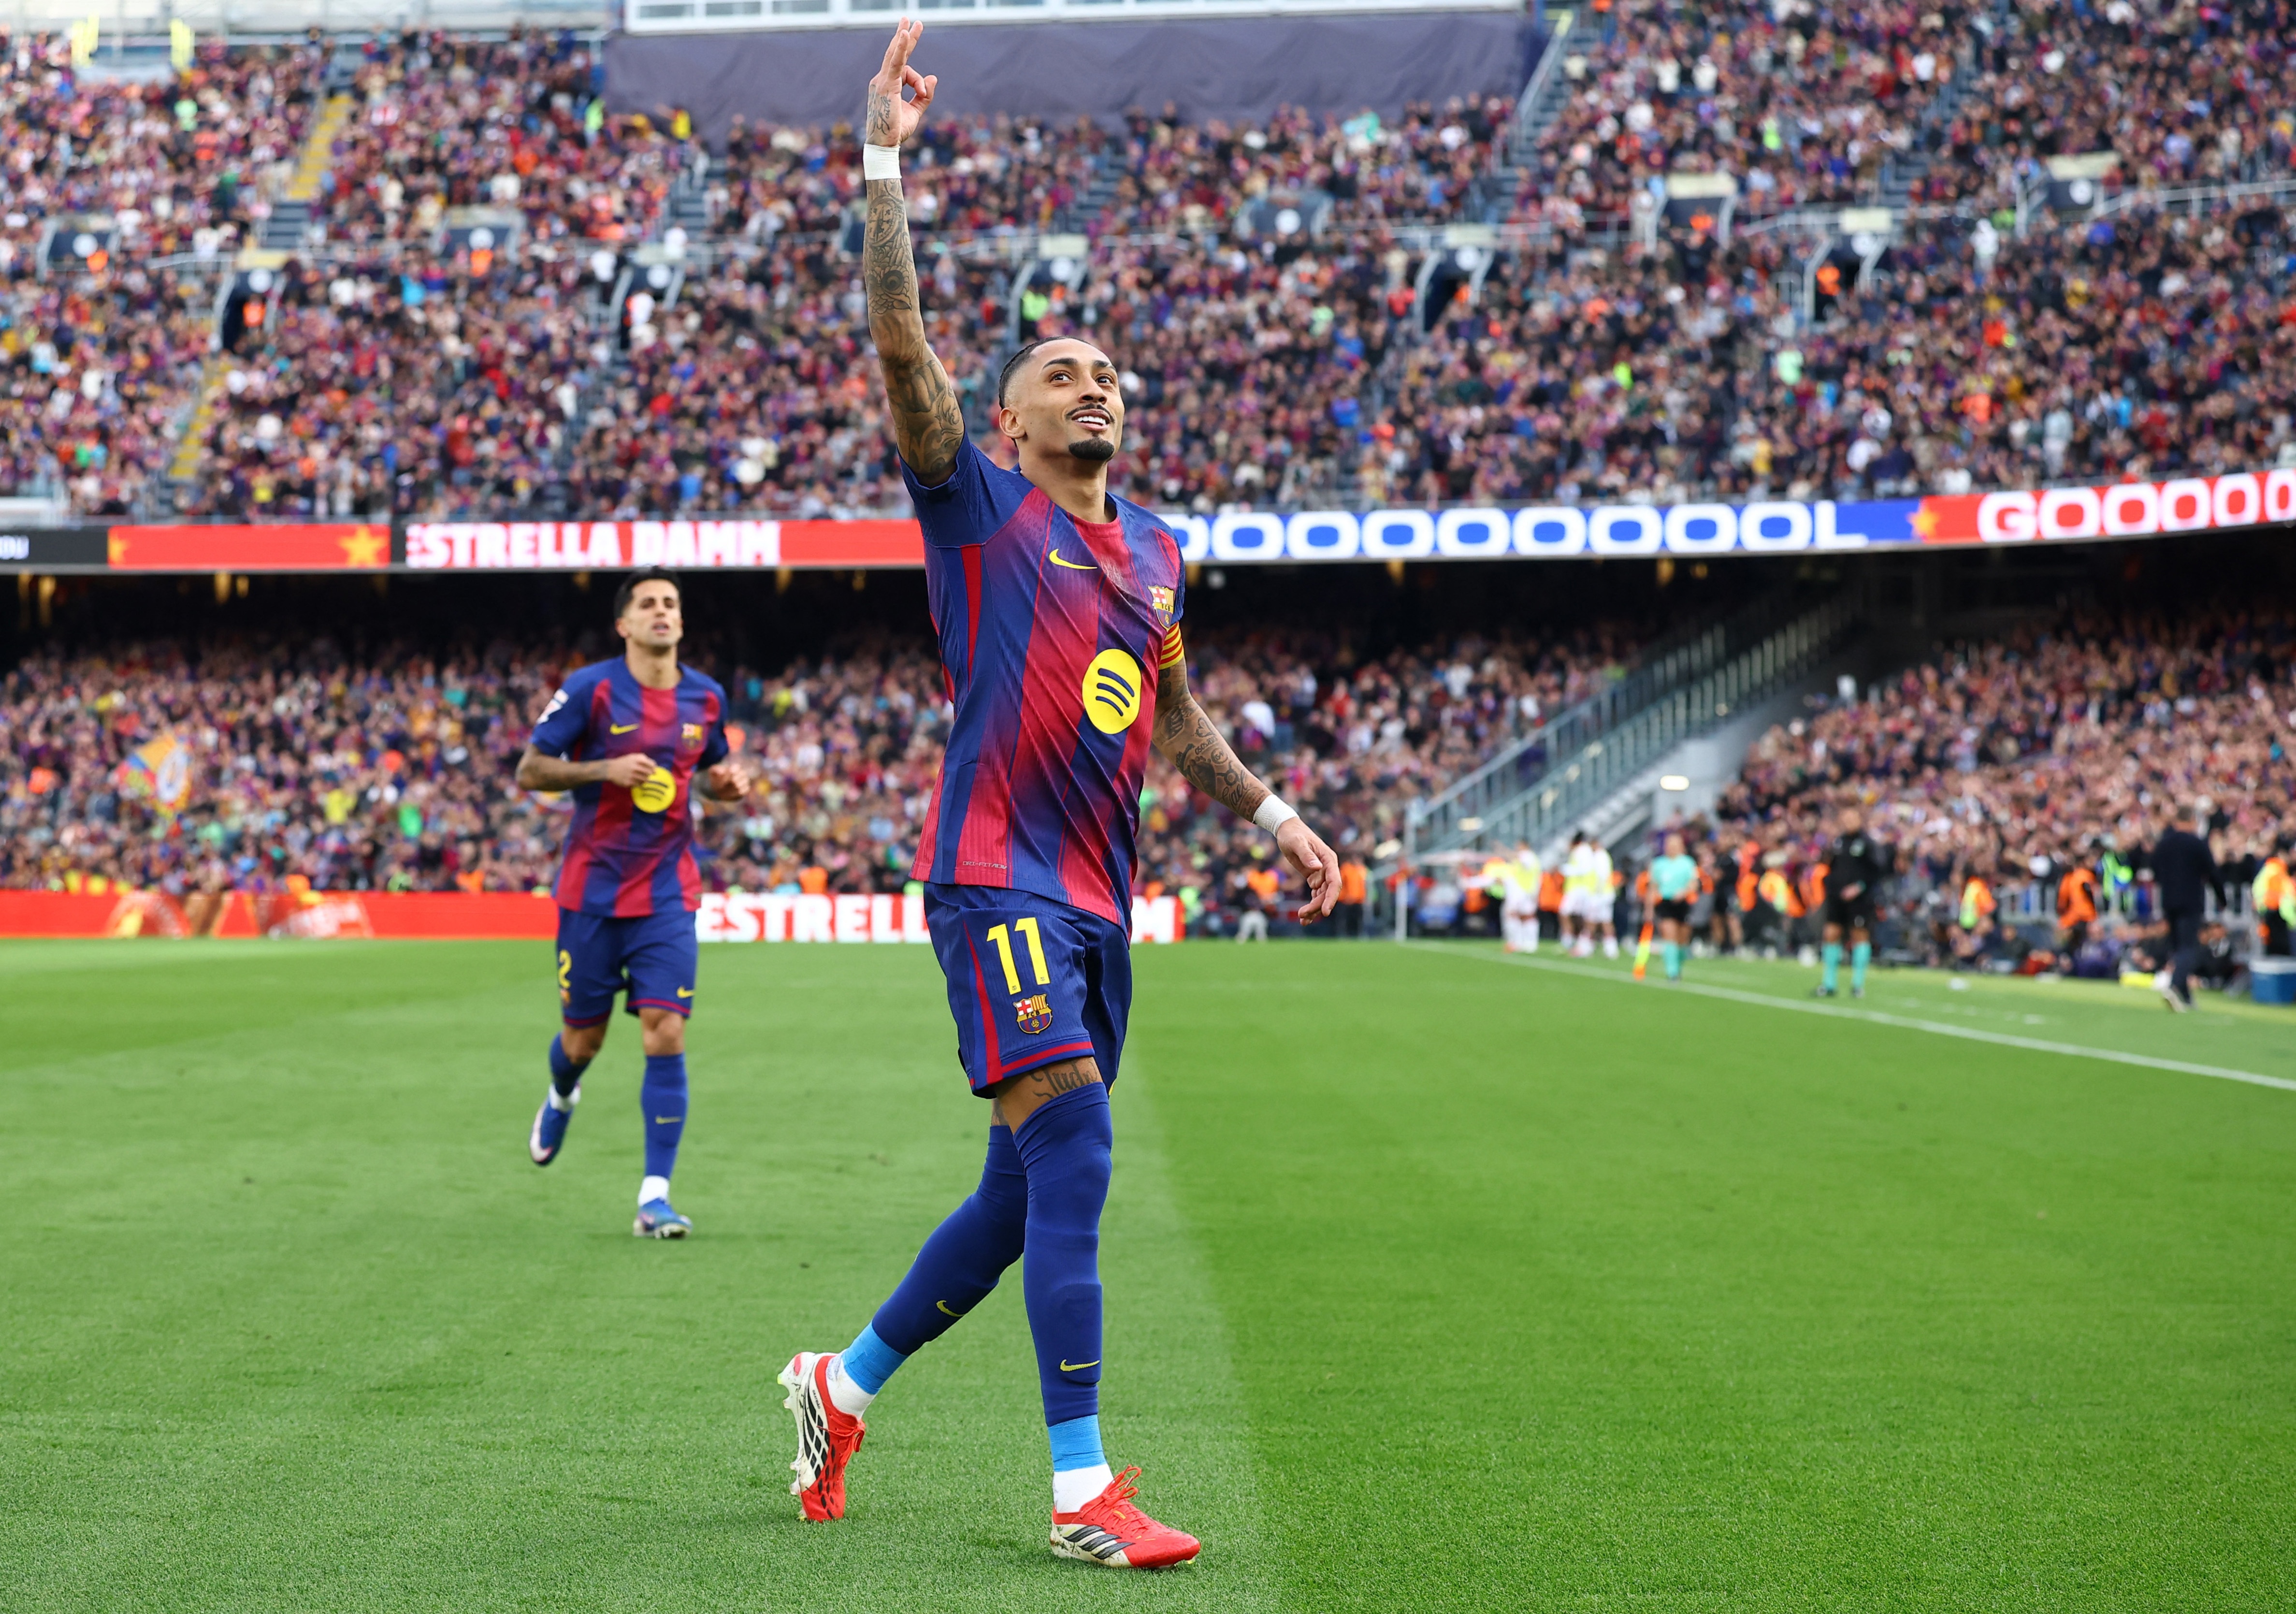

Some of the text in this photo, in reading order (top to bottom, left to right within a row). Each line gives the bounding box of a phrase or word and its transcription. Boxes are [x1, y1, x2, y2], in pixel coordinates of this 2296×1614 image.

[633, 521, 780, 567] DAMM
[1161, 603, 1170, 611] FCB
[695, 893, 932, 943] ESTRELL
[558, 949, 572, 989] 2
[986, 917, 1051, 995] 11
[1026, 1010, 1040, 1019] FCB
